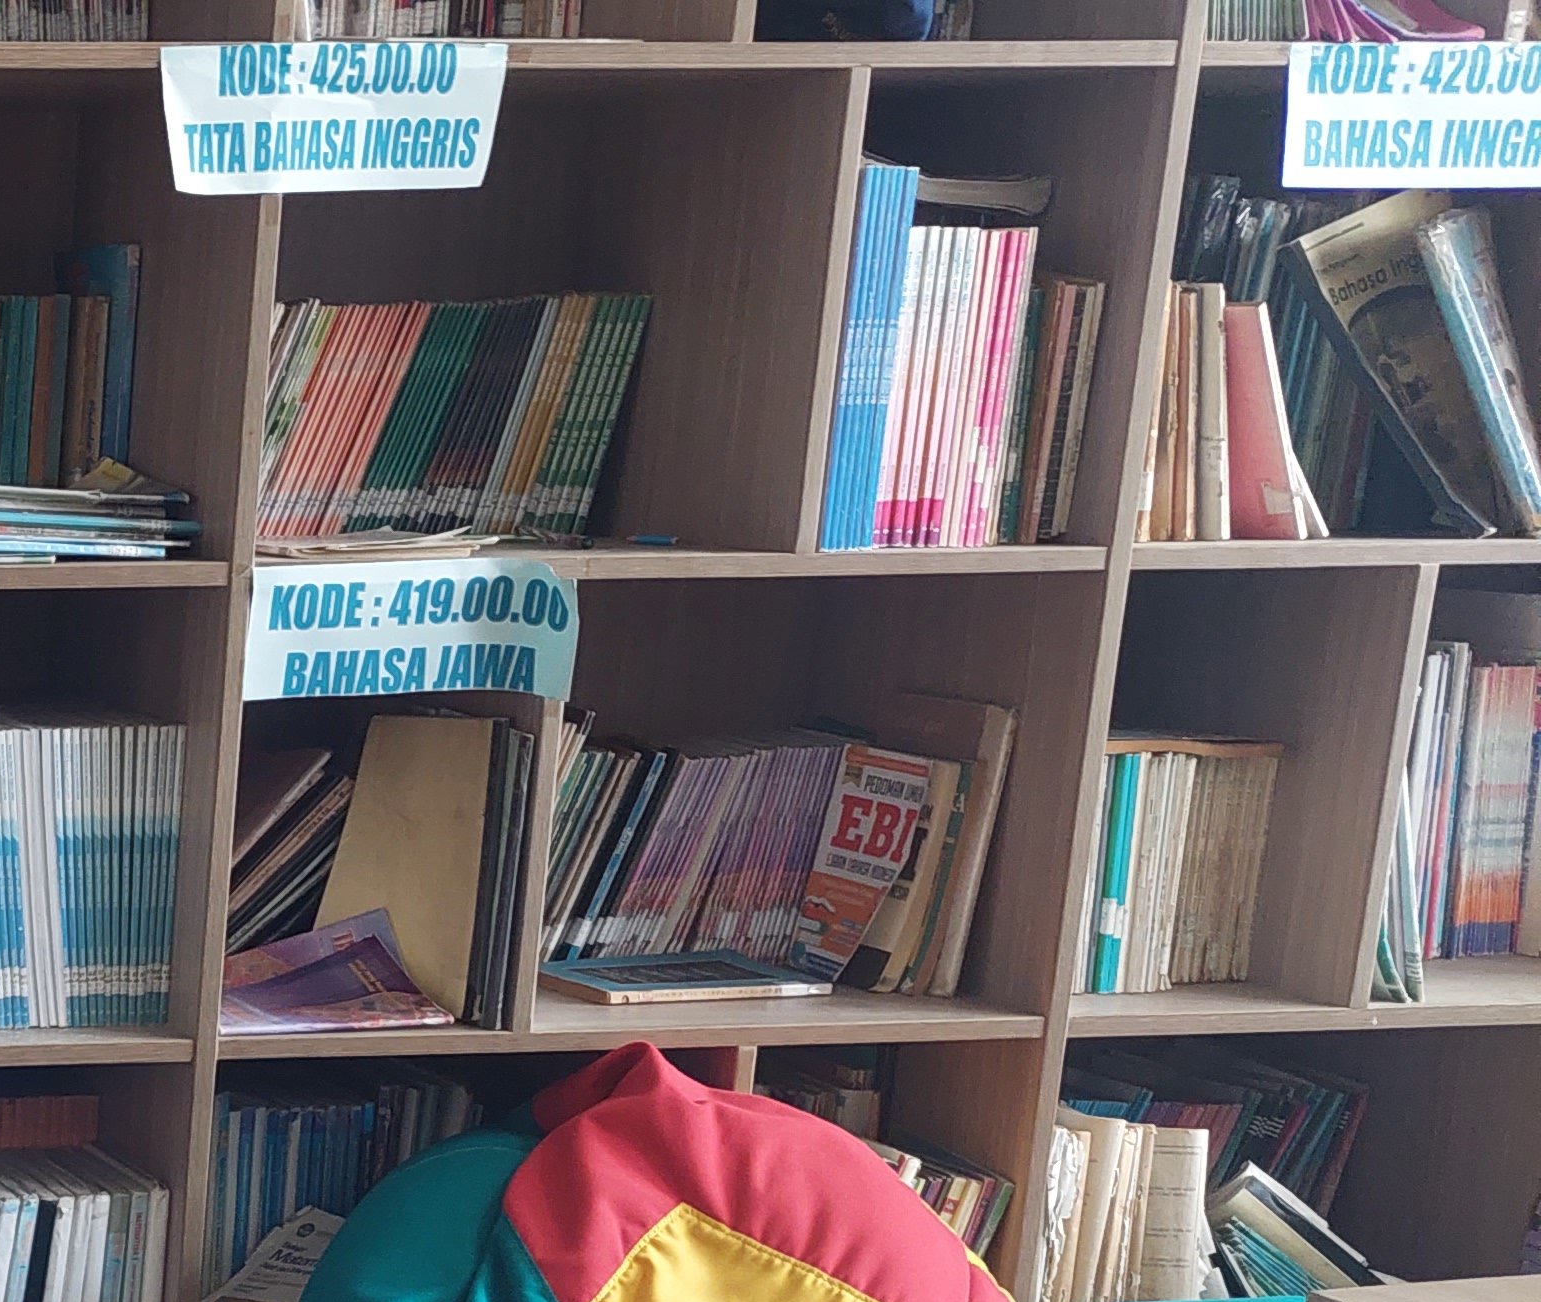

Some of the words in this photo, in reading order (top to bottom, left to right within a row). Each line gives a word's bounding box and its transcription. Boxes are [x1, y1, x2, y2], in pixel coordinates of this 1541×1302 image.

[219, 45, 293, 96] KODE
[310, 45, 457, 94] 425.00.00
[1307, 44, 1400, 94] KODE
[184, 122, 245, 173] TATA
[254, 121, 356, 171] BAHASA
[362, 118, 480, 169] INGGRIS
[1304, 121, 1430, 167] BAHASA
[1439, 120, 1541, 167] INNGR
[1328, 268, 1388, 305] Bahasa
[270, 584, 362, 631] KODE
[387, 576, 569, 631] 419.00.00
[283, 648, 428, 695] BAHASA
[434, 645, 536, 692] JAWA
[831, 794, 918, 862] EBI
